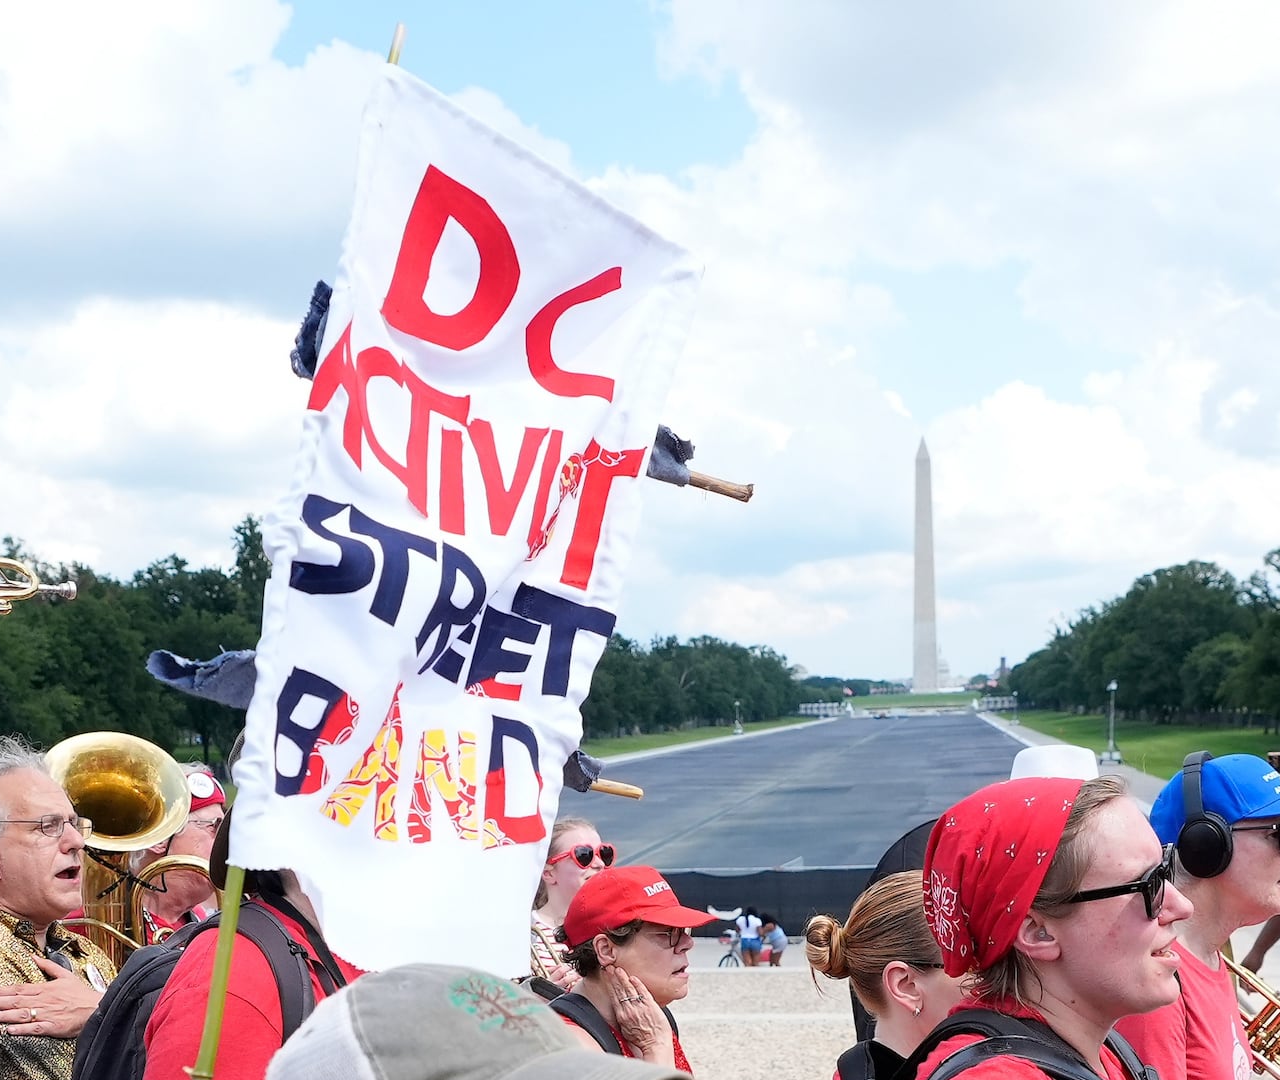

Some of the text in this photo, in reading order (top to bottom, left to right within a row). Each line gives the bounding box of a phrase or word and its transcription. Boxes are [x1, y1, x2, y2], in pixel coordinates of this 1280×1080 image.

[307, 321, 647, 591] ACTIVIT
[290, 493, 617, 701] STREET
[274, 666, 547, 850] BAND
[643, 880, 671, 897] IMPE
